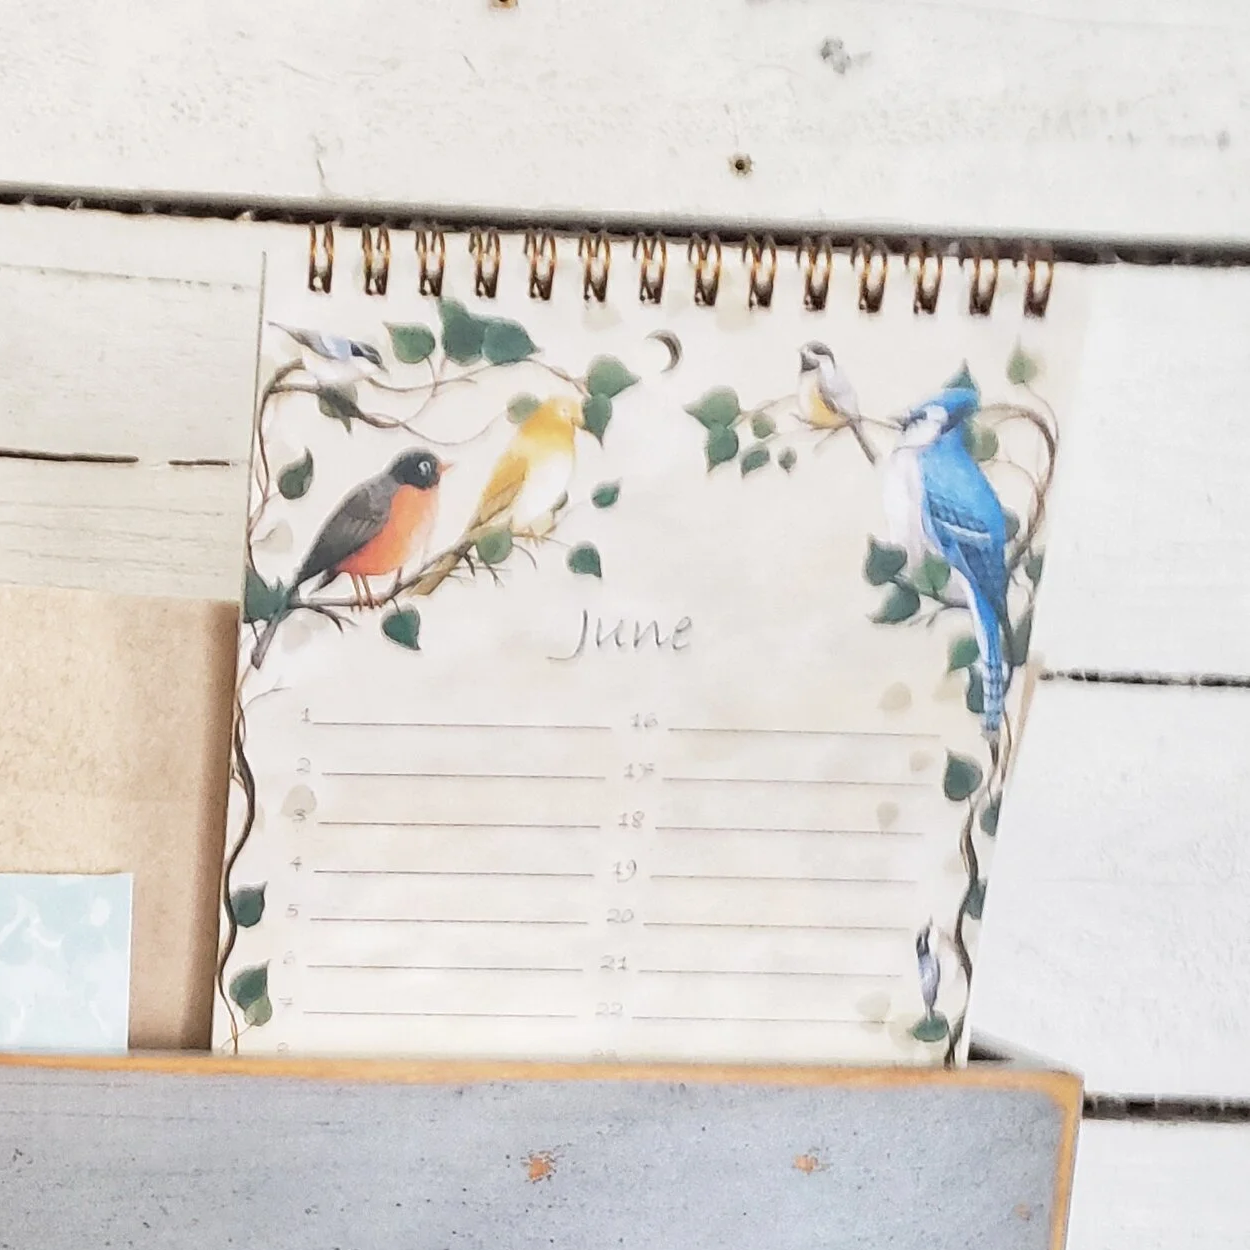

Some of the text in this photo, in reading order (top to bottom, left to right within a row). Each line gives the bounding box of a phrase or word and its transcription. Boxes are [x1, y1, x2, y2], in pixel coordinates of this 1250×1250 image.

[545, 608, 693, 661] June
[629, 711, 659, 729] 16
[296, 757, 311, 773] 2
[292, 808, 307, 823] 3
[617, 810, 645, 829] 18
[288, 855, 303, 873] 4
[612, 858, 638, 882] 19
[285, 903, 301, 919] 5
[605, 907, 635, 924] 20
[599, 954, 628, 971] 21
[594, 1001, 624, 1018] 22
